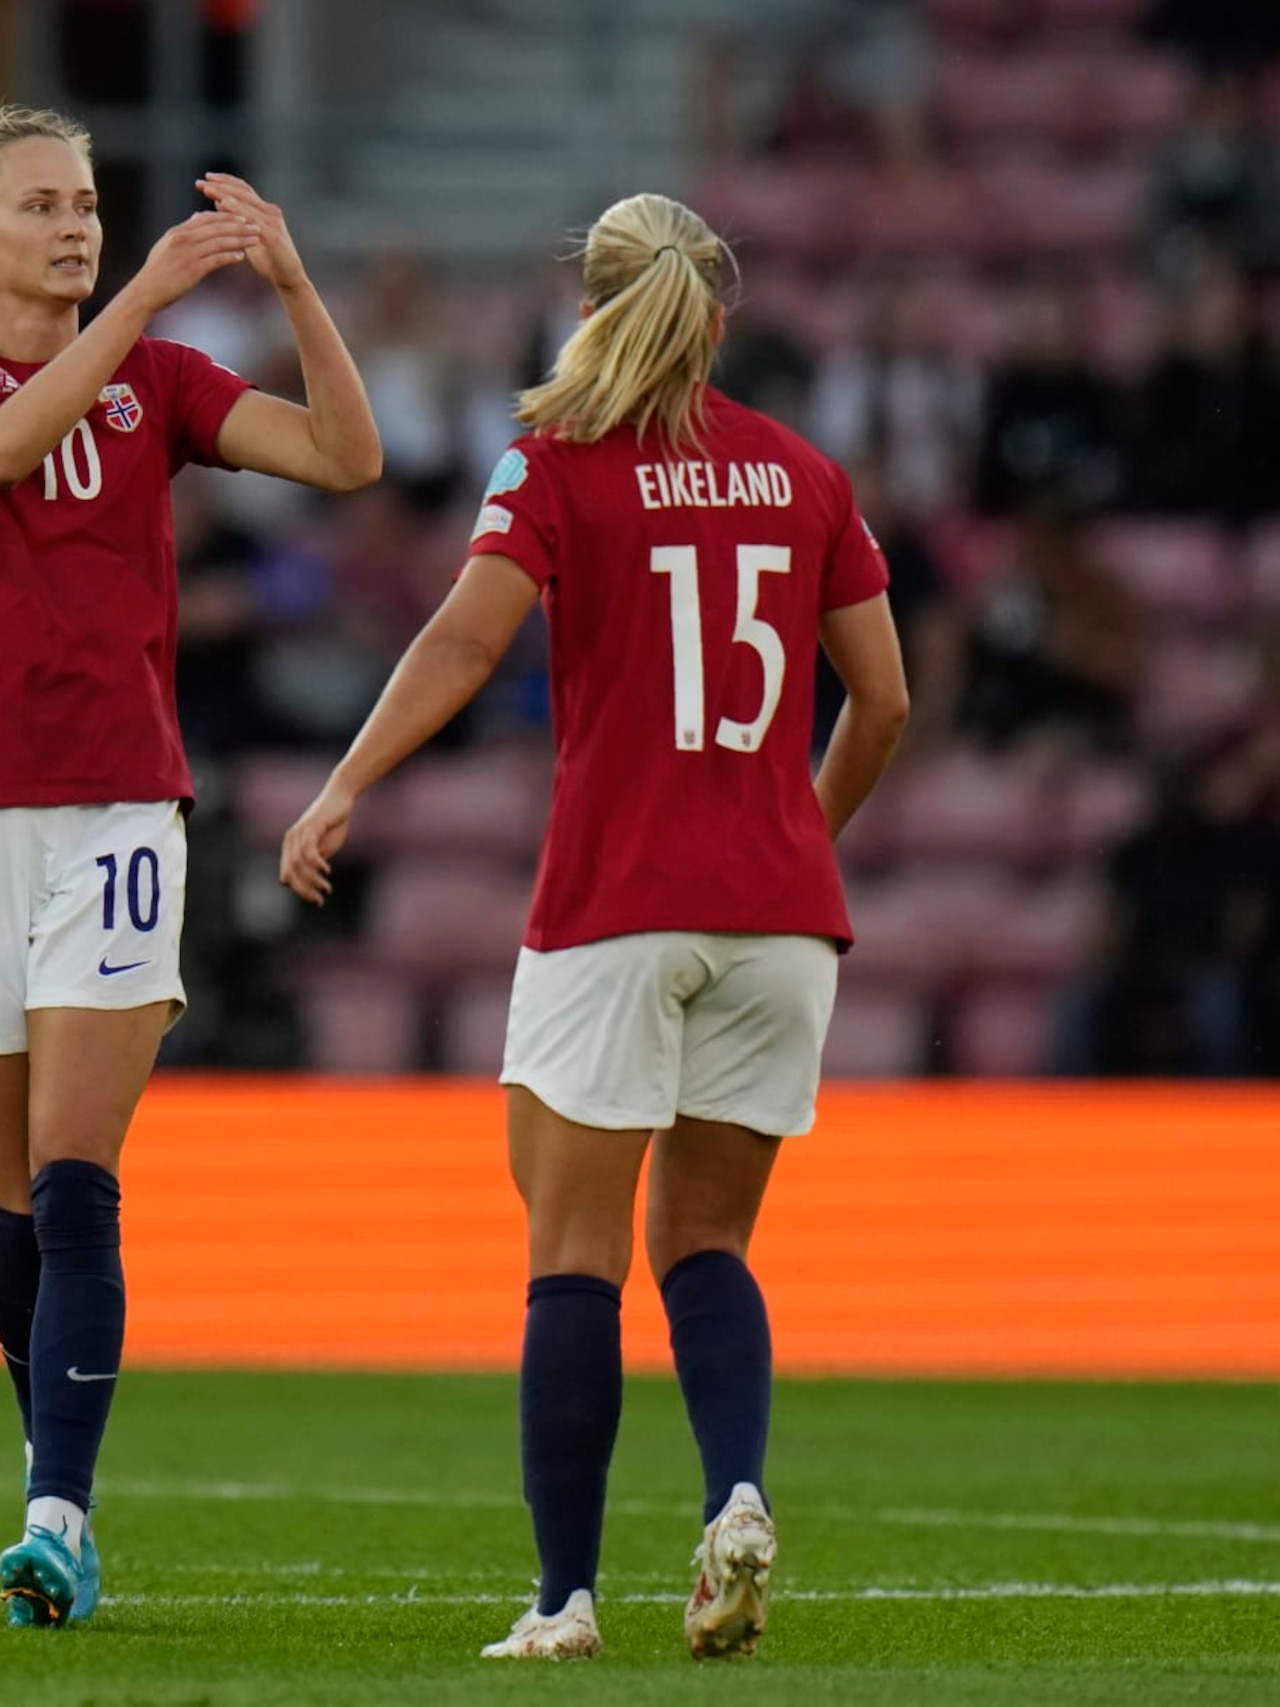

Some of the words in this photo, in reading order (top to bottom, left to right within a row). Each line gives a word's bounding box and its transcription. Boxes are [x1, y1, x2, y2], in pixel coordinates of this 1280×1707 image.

[42, 417, 103, 501] 10
[635, 461, 791, 510] EIKELAND
[650, 544, 792, 753] 15
[95, 846, 160, 933] 10
